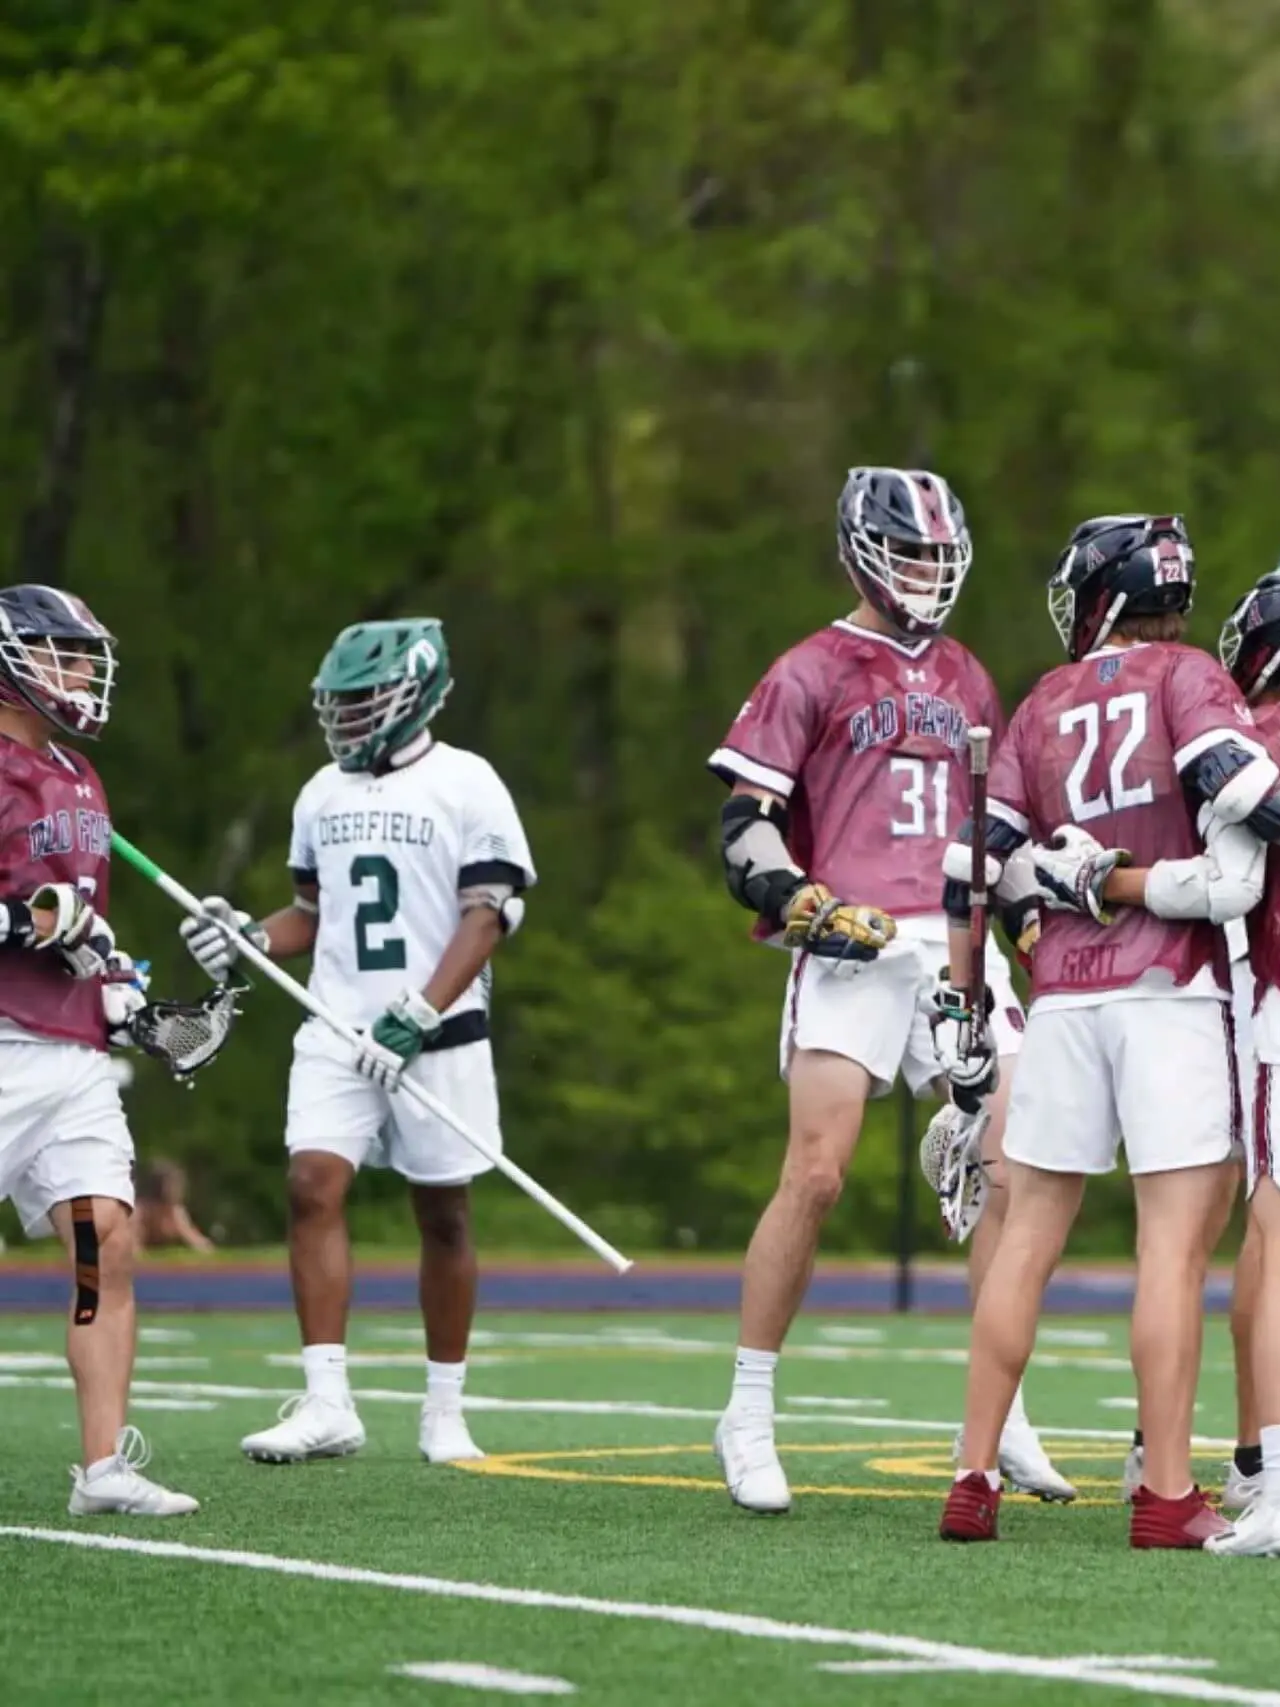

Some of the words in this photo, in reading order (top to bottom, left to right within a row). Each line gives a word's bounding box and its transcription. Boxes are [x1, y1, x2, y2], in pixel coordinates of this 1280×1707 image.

[1059, 691, 1154, 822] 22
[319, 810, 435, 847] DEERFIELD
[890, 758, 949, 838] 31
[350, 855, 407, 971] 2
[1060, 942, 1122, 983] GRIT
